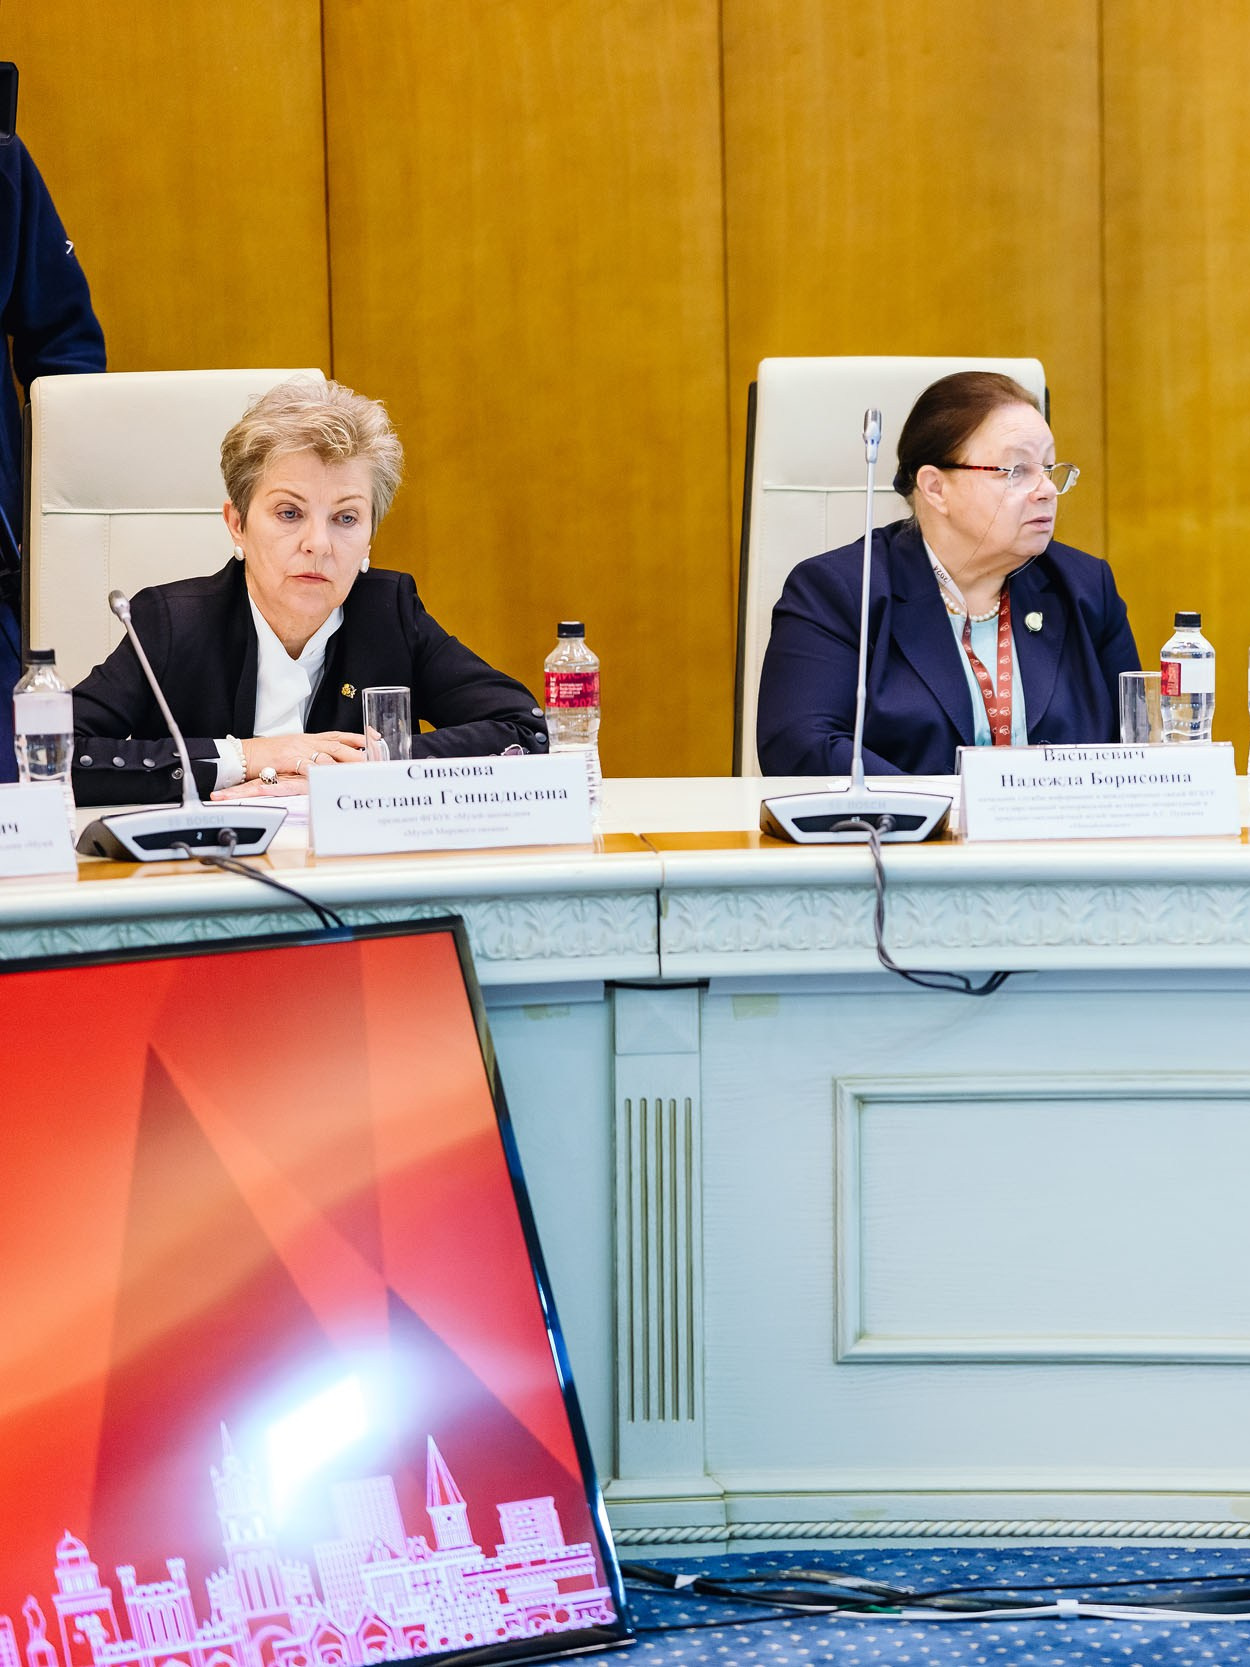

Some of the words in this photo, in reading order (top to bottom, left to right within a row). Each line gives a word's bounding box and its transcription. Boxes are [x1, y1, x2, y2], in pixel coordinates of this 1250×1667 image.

[1043, 748, 1145, 762] Василевич
[407, 763, 494, 780] Сивкова
[1001, 774, 1083, 788] Надежда
[1091, 771, 1192, 788] Борисовна
[336, 794, 433, 810] Светлана
[440, 788, 568, 805] Геннадьевна
[186, 815, 225, 827] BOSCH
